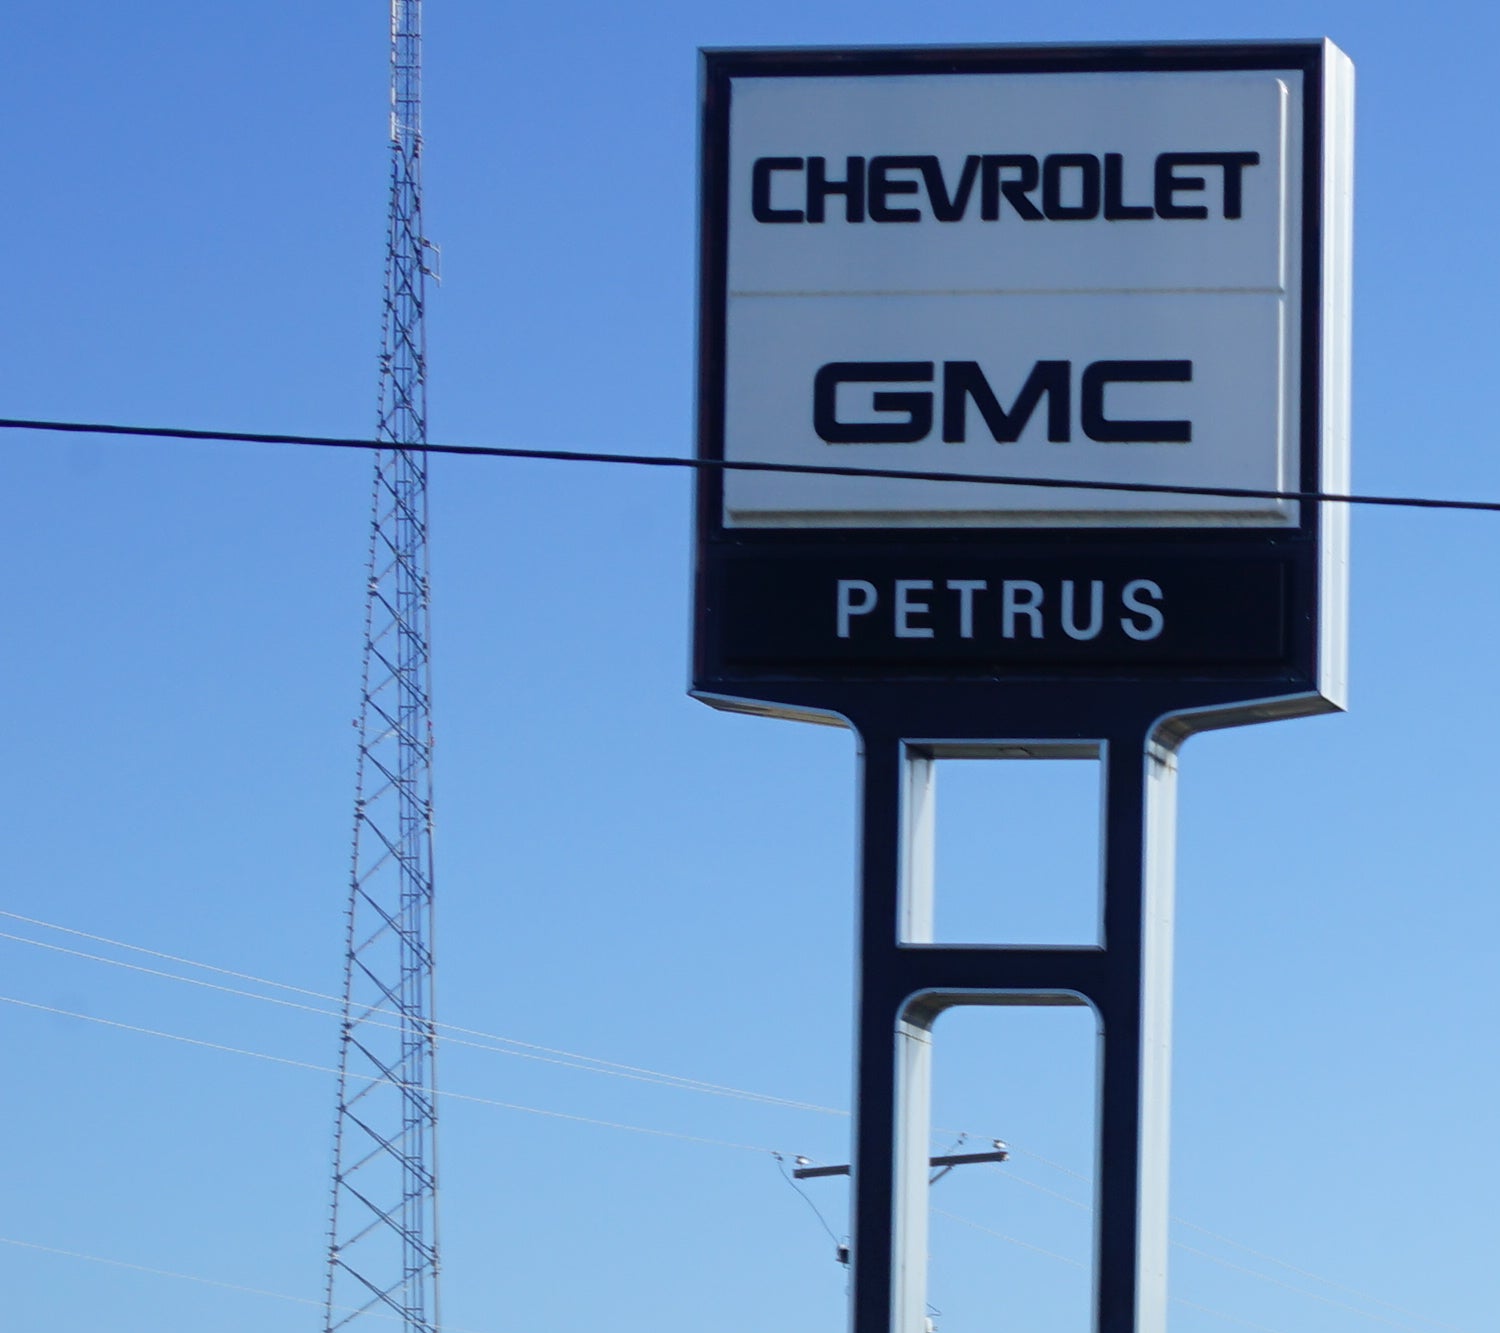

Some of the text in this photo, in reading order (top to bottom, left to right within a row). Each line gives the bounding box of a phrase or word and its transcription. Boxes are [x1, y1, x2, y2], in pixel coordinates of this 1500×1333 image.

[752, 152, 1260, 224] CHEVROLET
[813, 360, 1193, 443] GMC
[835, 579, 1165, 641] PETRUS
